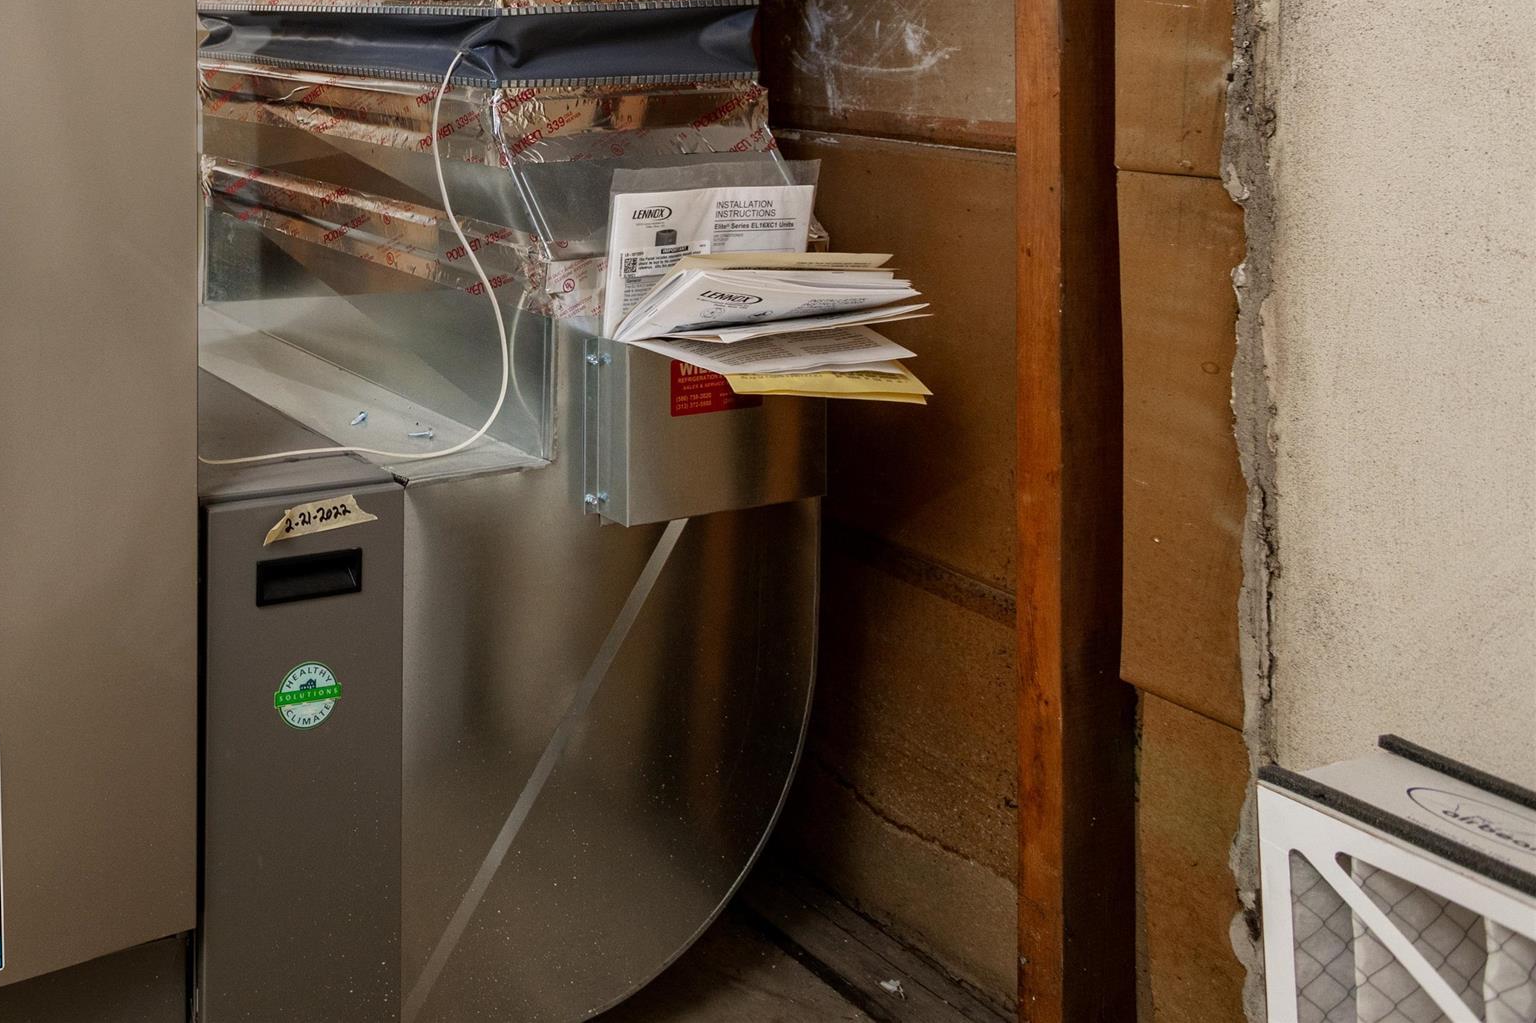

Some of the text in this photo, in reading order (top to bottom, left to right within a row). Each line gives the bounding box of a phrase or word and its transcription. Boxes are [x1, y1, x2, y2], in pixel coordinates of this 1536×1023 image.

[456, 115, 469, 130] 339
[546, 116, 565, 134] 339
[716, 200, 773, 209] INSTALLATION
[632, 208, 665, 220] LENNOX
[716, 209, 776, 218] INSTRUCTIONS
[484, 232, 500, 245] 339
[700, 290, 752, 304] LENNOX
[285, 504, 351, 533] 2-21-2022
[286, 666, 332, 689] HEALTHY
[279, 687, 338, 702] SOLUTIONS
[286, 703, 332, 724] CLIMATE
